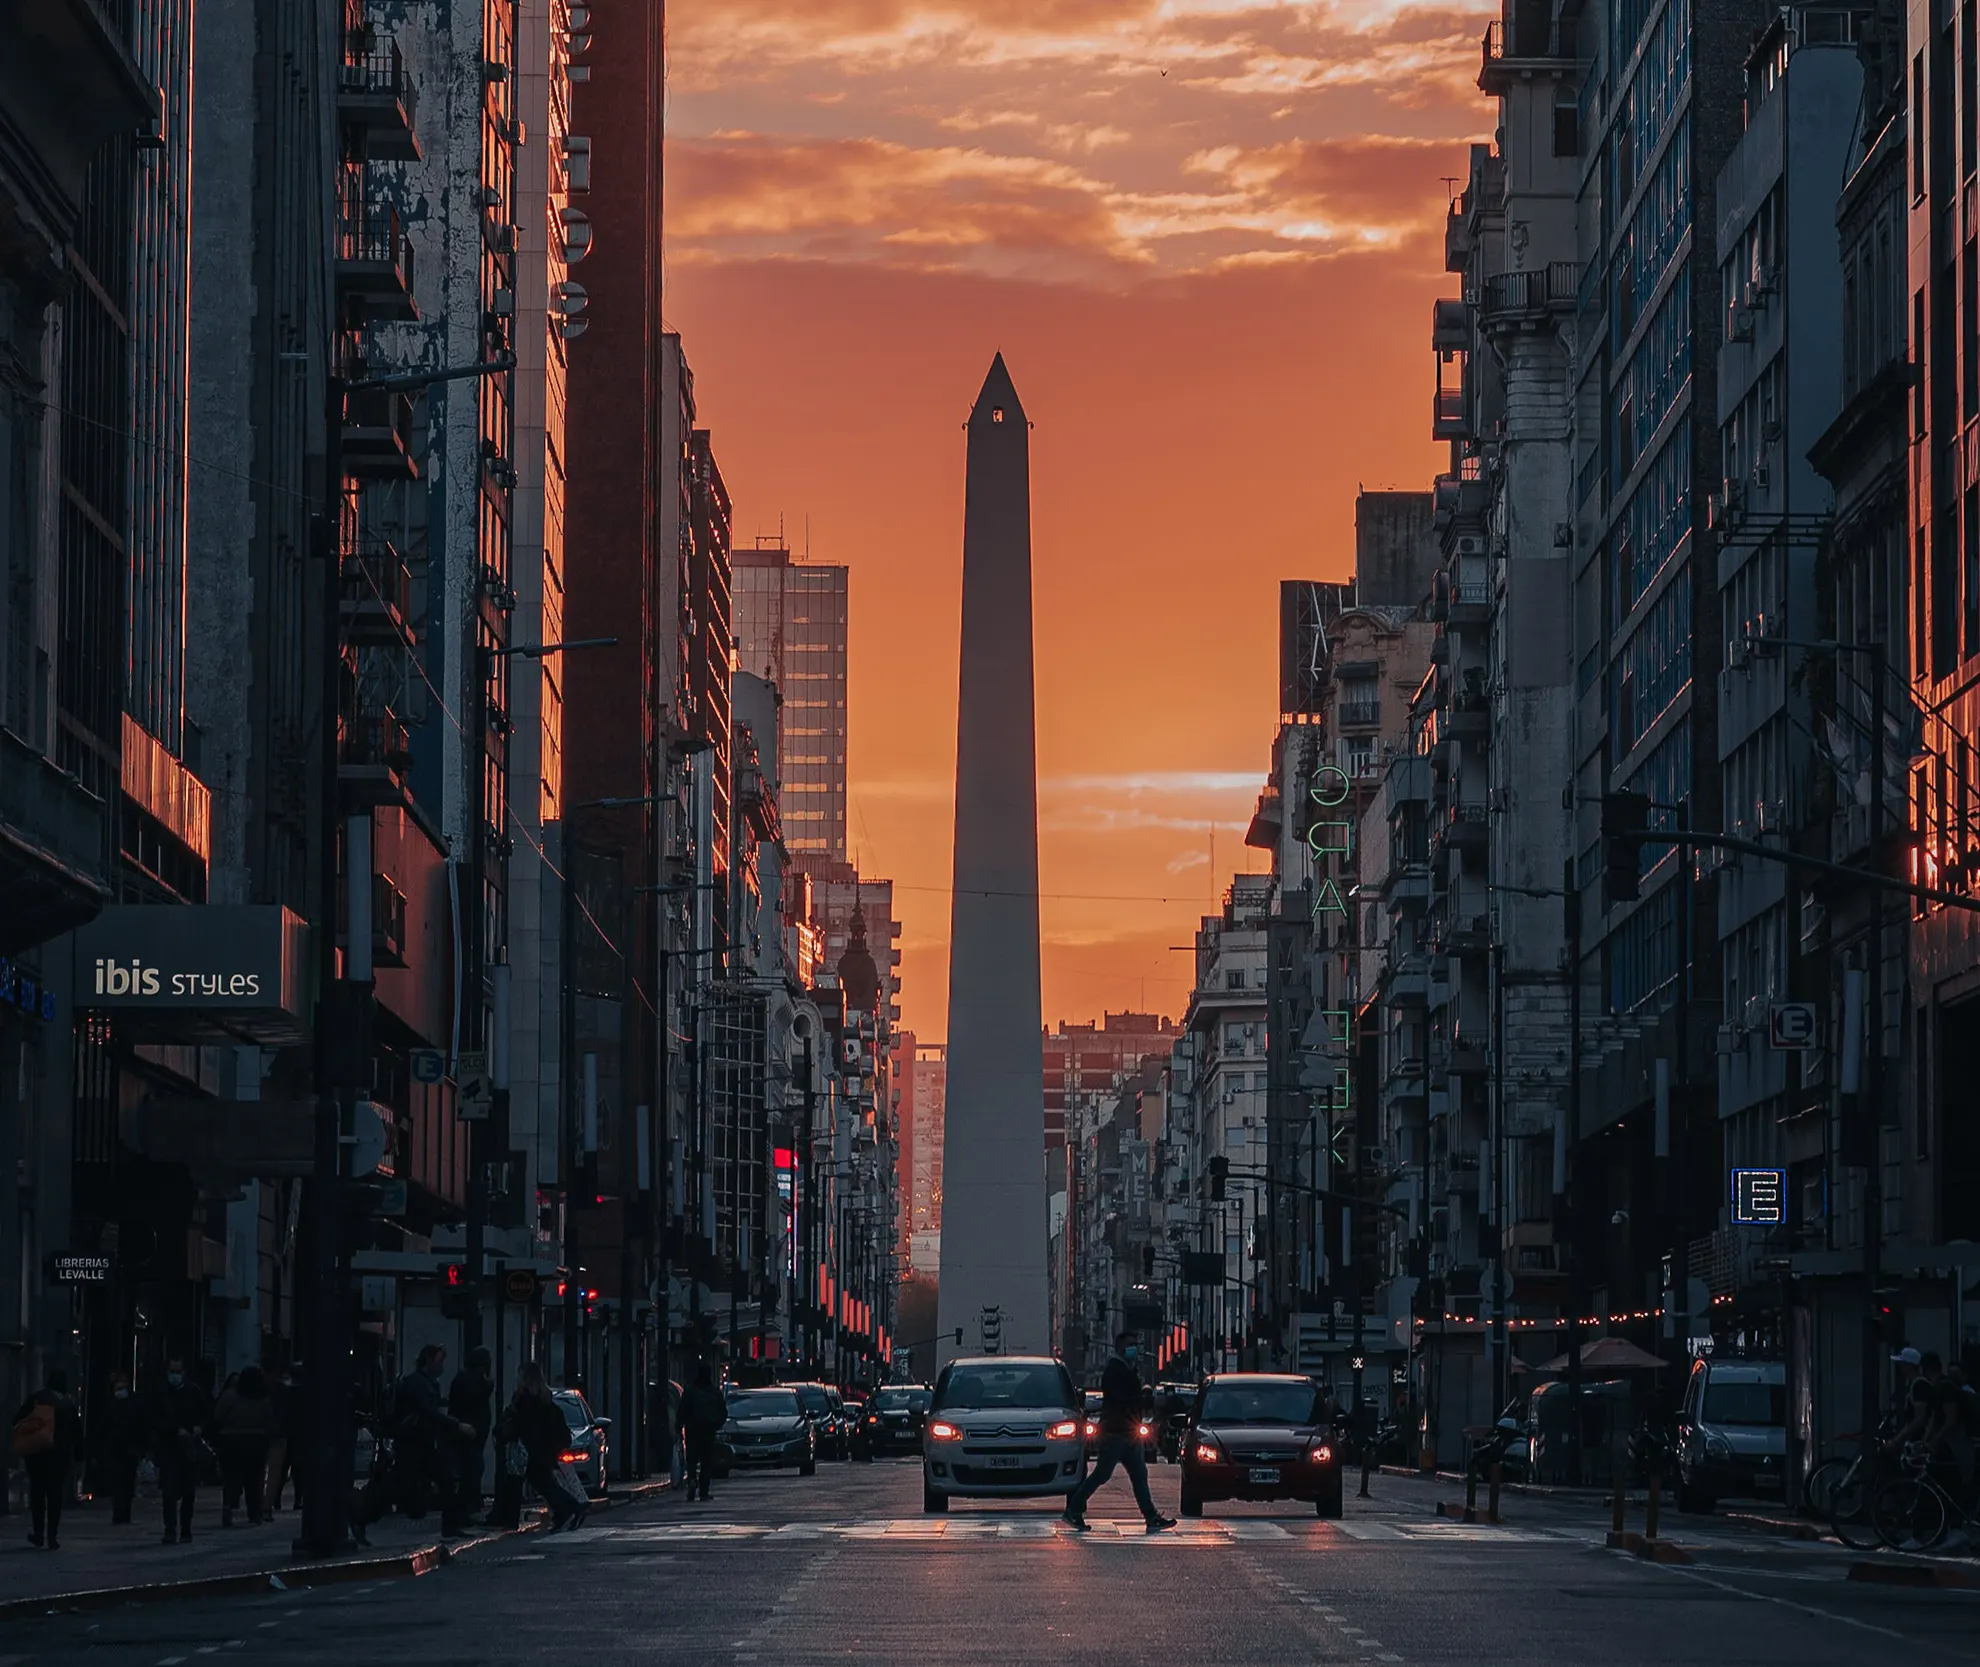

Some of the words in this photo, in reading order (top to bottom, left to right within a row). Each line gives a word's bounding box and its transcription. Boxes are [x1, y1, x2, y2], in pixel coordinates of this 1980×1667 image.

[95, 958, 161, 996] ibis
[1782, 1009, 1807, 1038] E
[417, 1055, 437, 1077] E
[1131, 1151, 1147, 1218] MET
[1737, 1170, 1780, 1221] E
[55, 1257, 110, 1268] LIBRERIAS
[59, 1269, 105, 1280] LEVALLE
